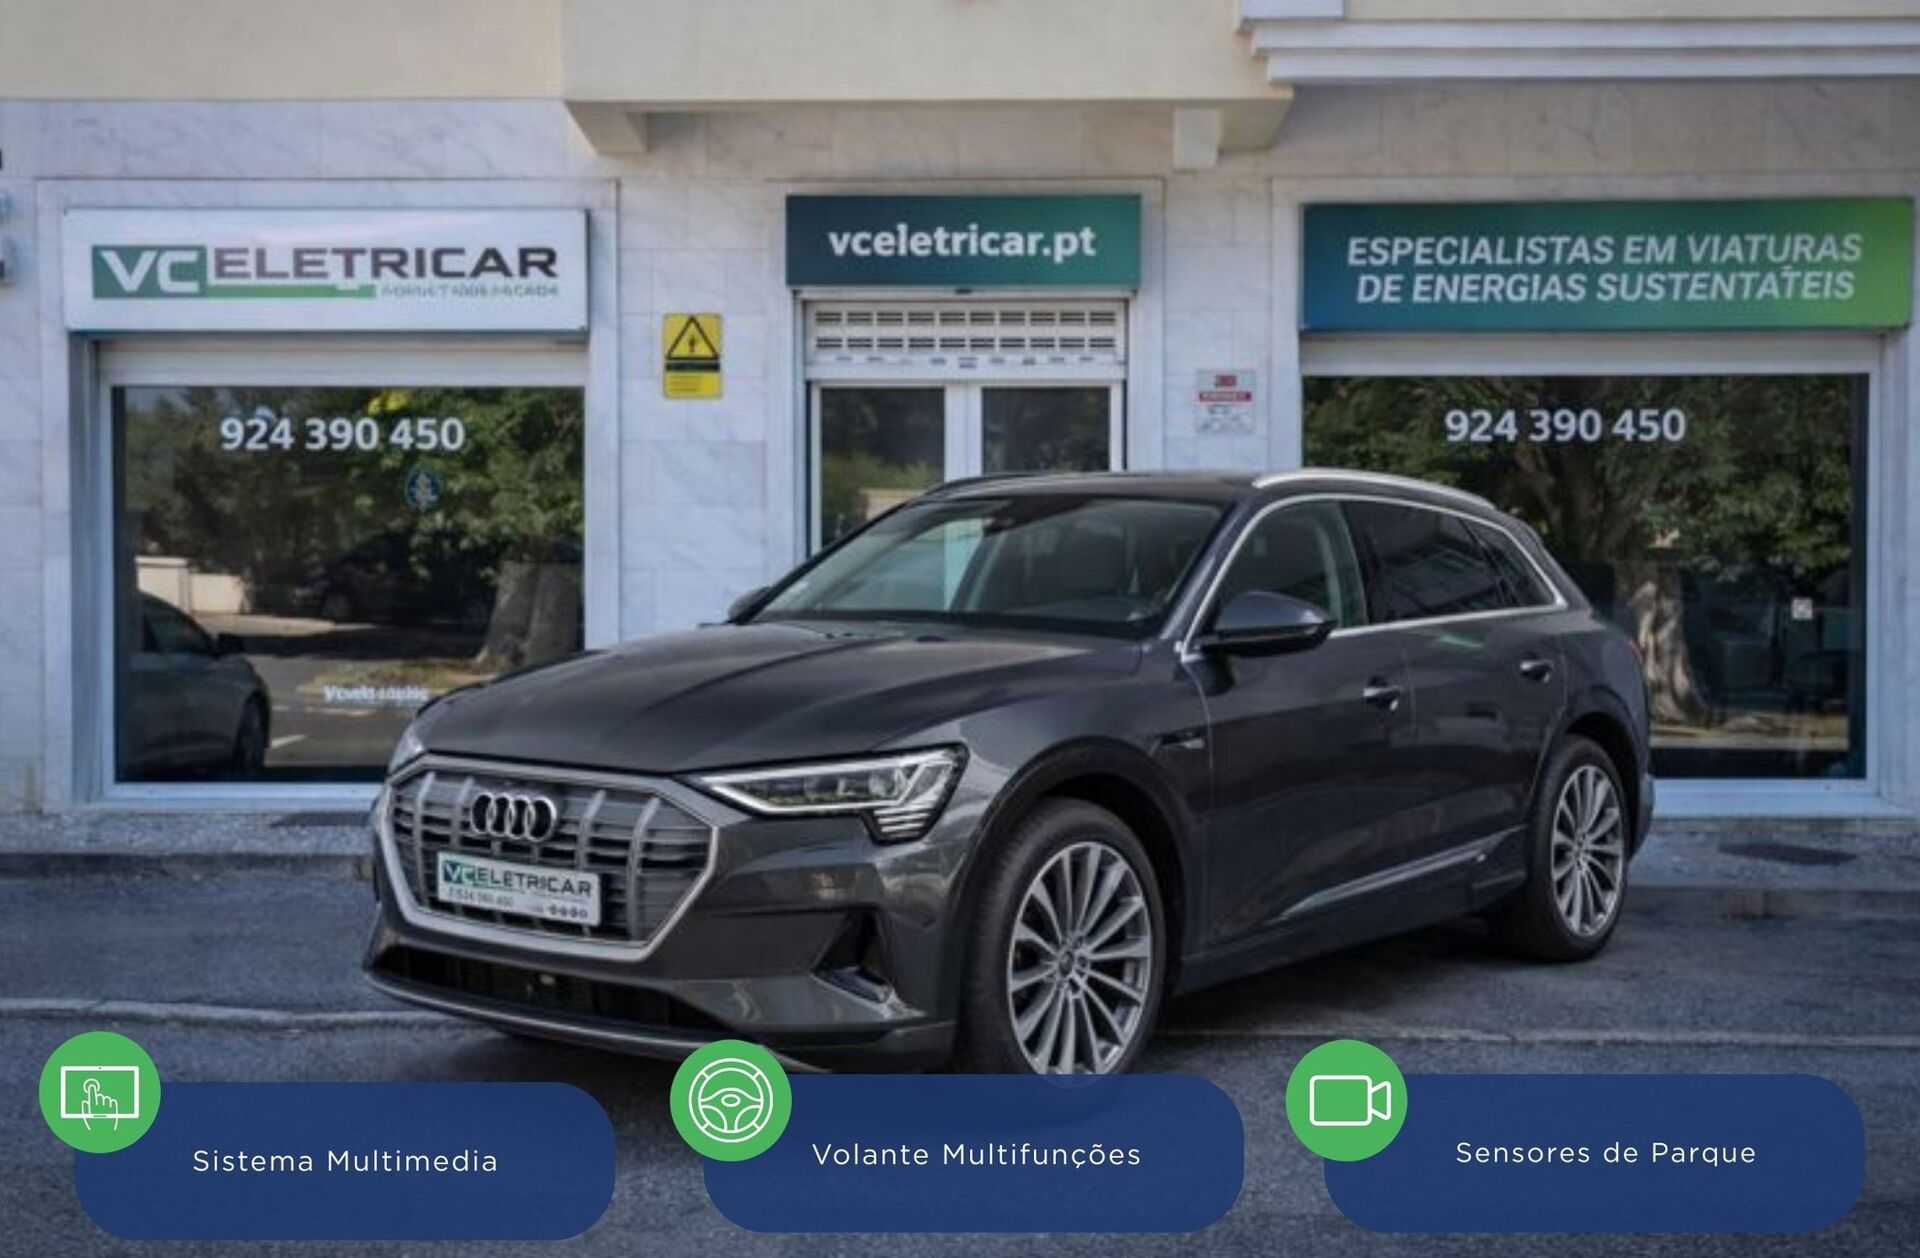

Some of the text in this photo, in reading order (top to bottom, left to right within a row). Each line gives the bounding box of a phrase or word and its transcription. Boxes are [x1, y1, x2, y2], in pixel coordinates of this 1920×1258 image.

[828, 222, 1097, 264] vceletricar.pt
[1347, 233, 1864, 266] ESPECIALISTAS EM VIATURAS
[1357, 273, 1404, 303] DE
[1412, 272, 1588, 303] ENERGIAS
[220, 417, 466, 450] 924 390 450
[1445, 409, 1686, 442] 924 390 450
